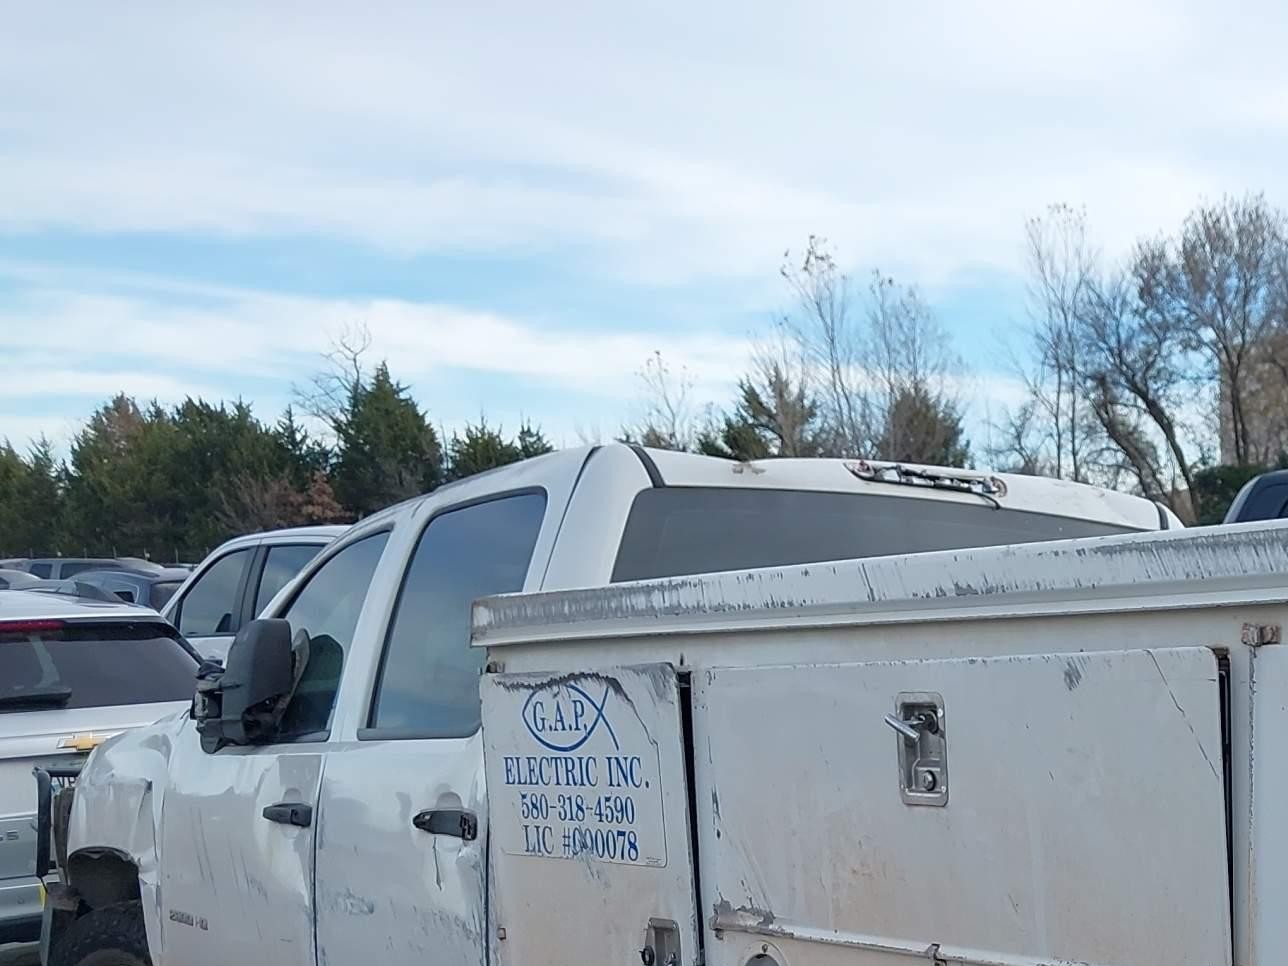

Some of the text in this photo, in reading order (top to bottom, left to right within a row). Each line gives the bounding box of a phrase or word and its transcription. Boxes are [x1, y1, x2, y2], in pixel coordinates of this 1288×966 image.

[532, 698, 588, 733] G.A.P.
[503, 756, 650, 789] ELECTRIC INC.
[520, 793, 636, 825] 580-318-4590
[522, 824, 555, 855] LIC
